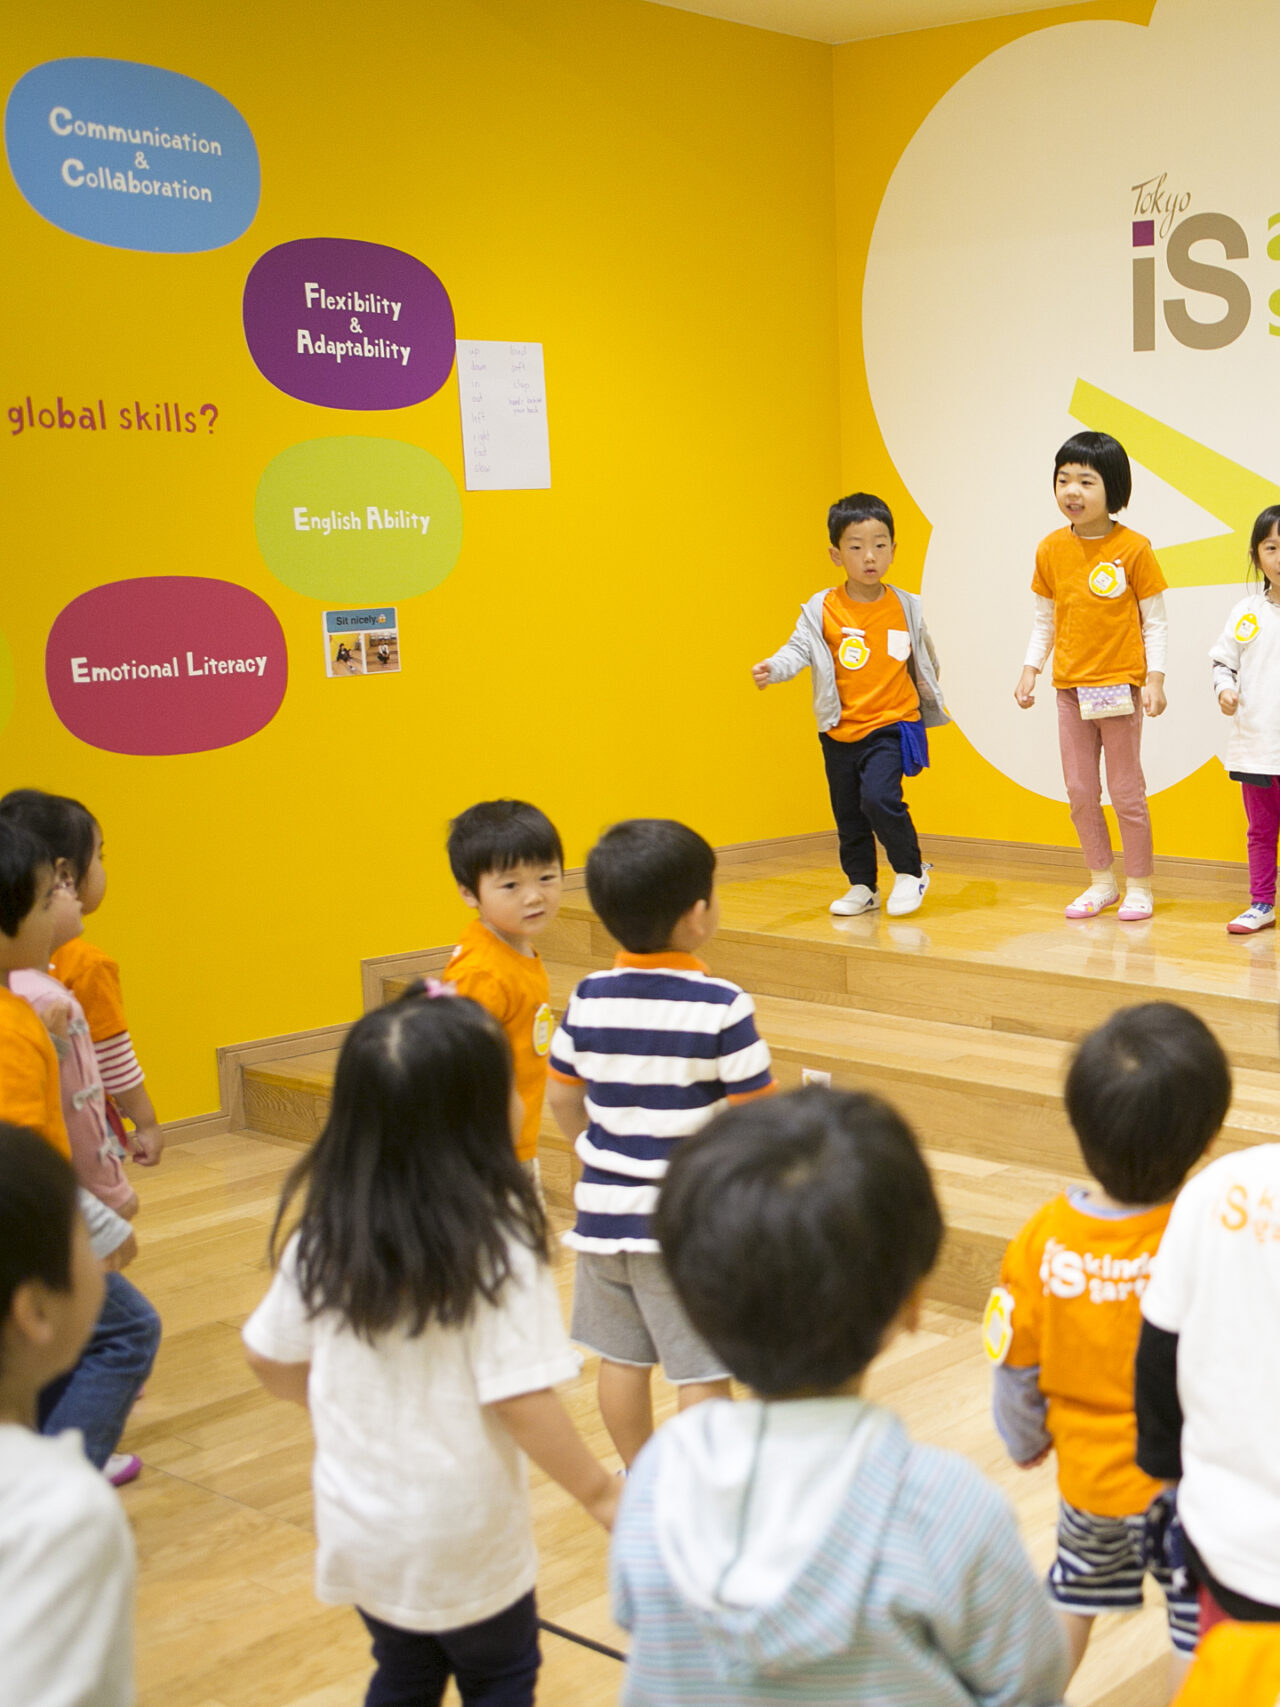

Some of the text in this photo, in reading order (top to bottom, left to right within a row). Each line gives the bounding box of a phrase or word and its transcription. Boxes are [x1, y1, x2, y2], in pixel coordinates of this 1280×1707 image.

[48, 106, 222, 156] Communication
[134, 151, 149, 169] &
[61, 158, 212, 203] Collaboration
[1131, 172, 1191, 239] Tokyo
[1132, 212, 1251, 351] iS
[304, 282, 402, 321] Flexibility
[350, 317, 362, 333] &
[297, 329, 411, 366] Adaptability
[8, 396, 218, 436] global skills?
[293, 506, 430, 535] English Ability
[336, 616, 348, 625] Sit
[71, 652, 267, 683] Emotional Literacy
